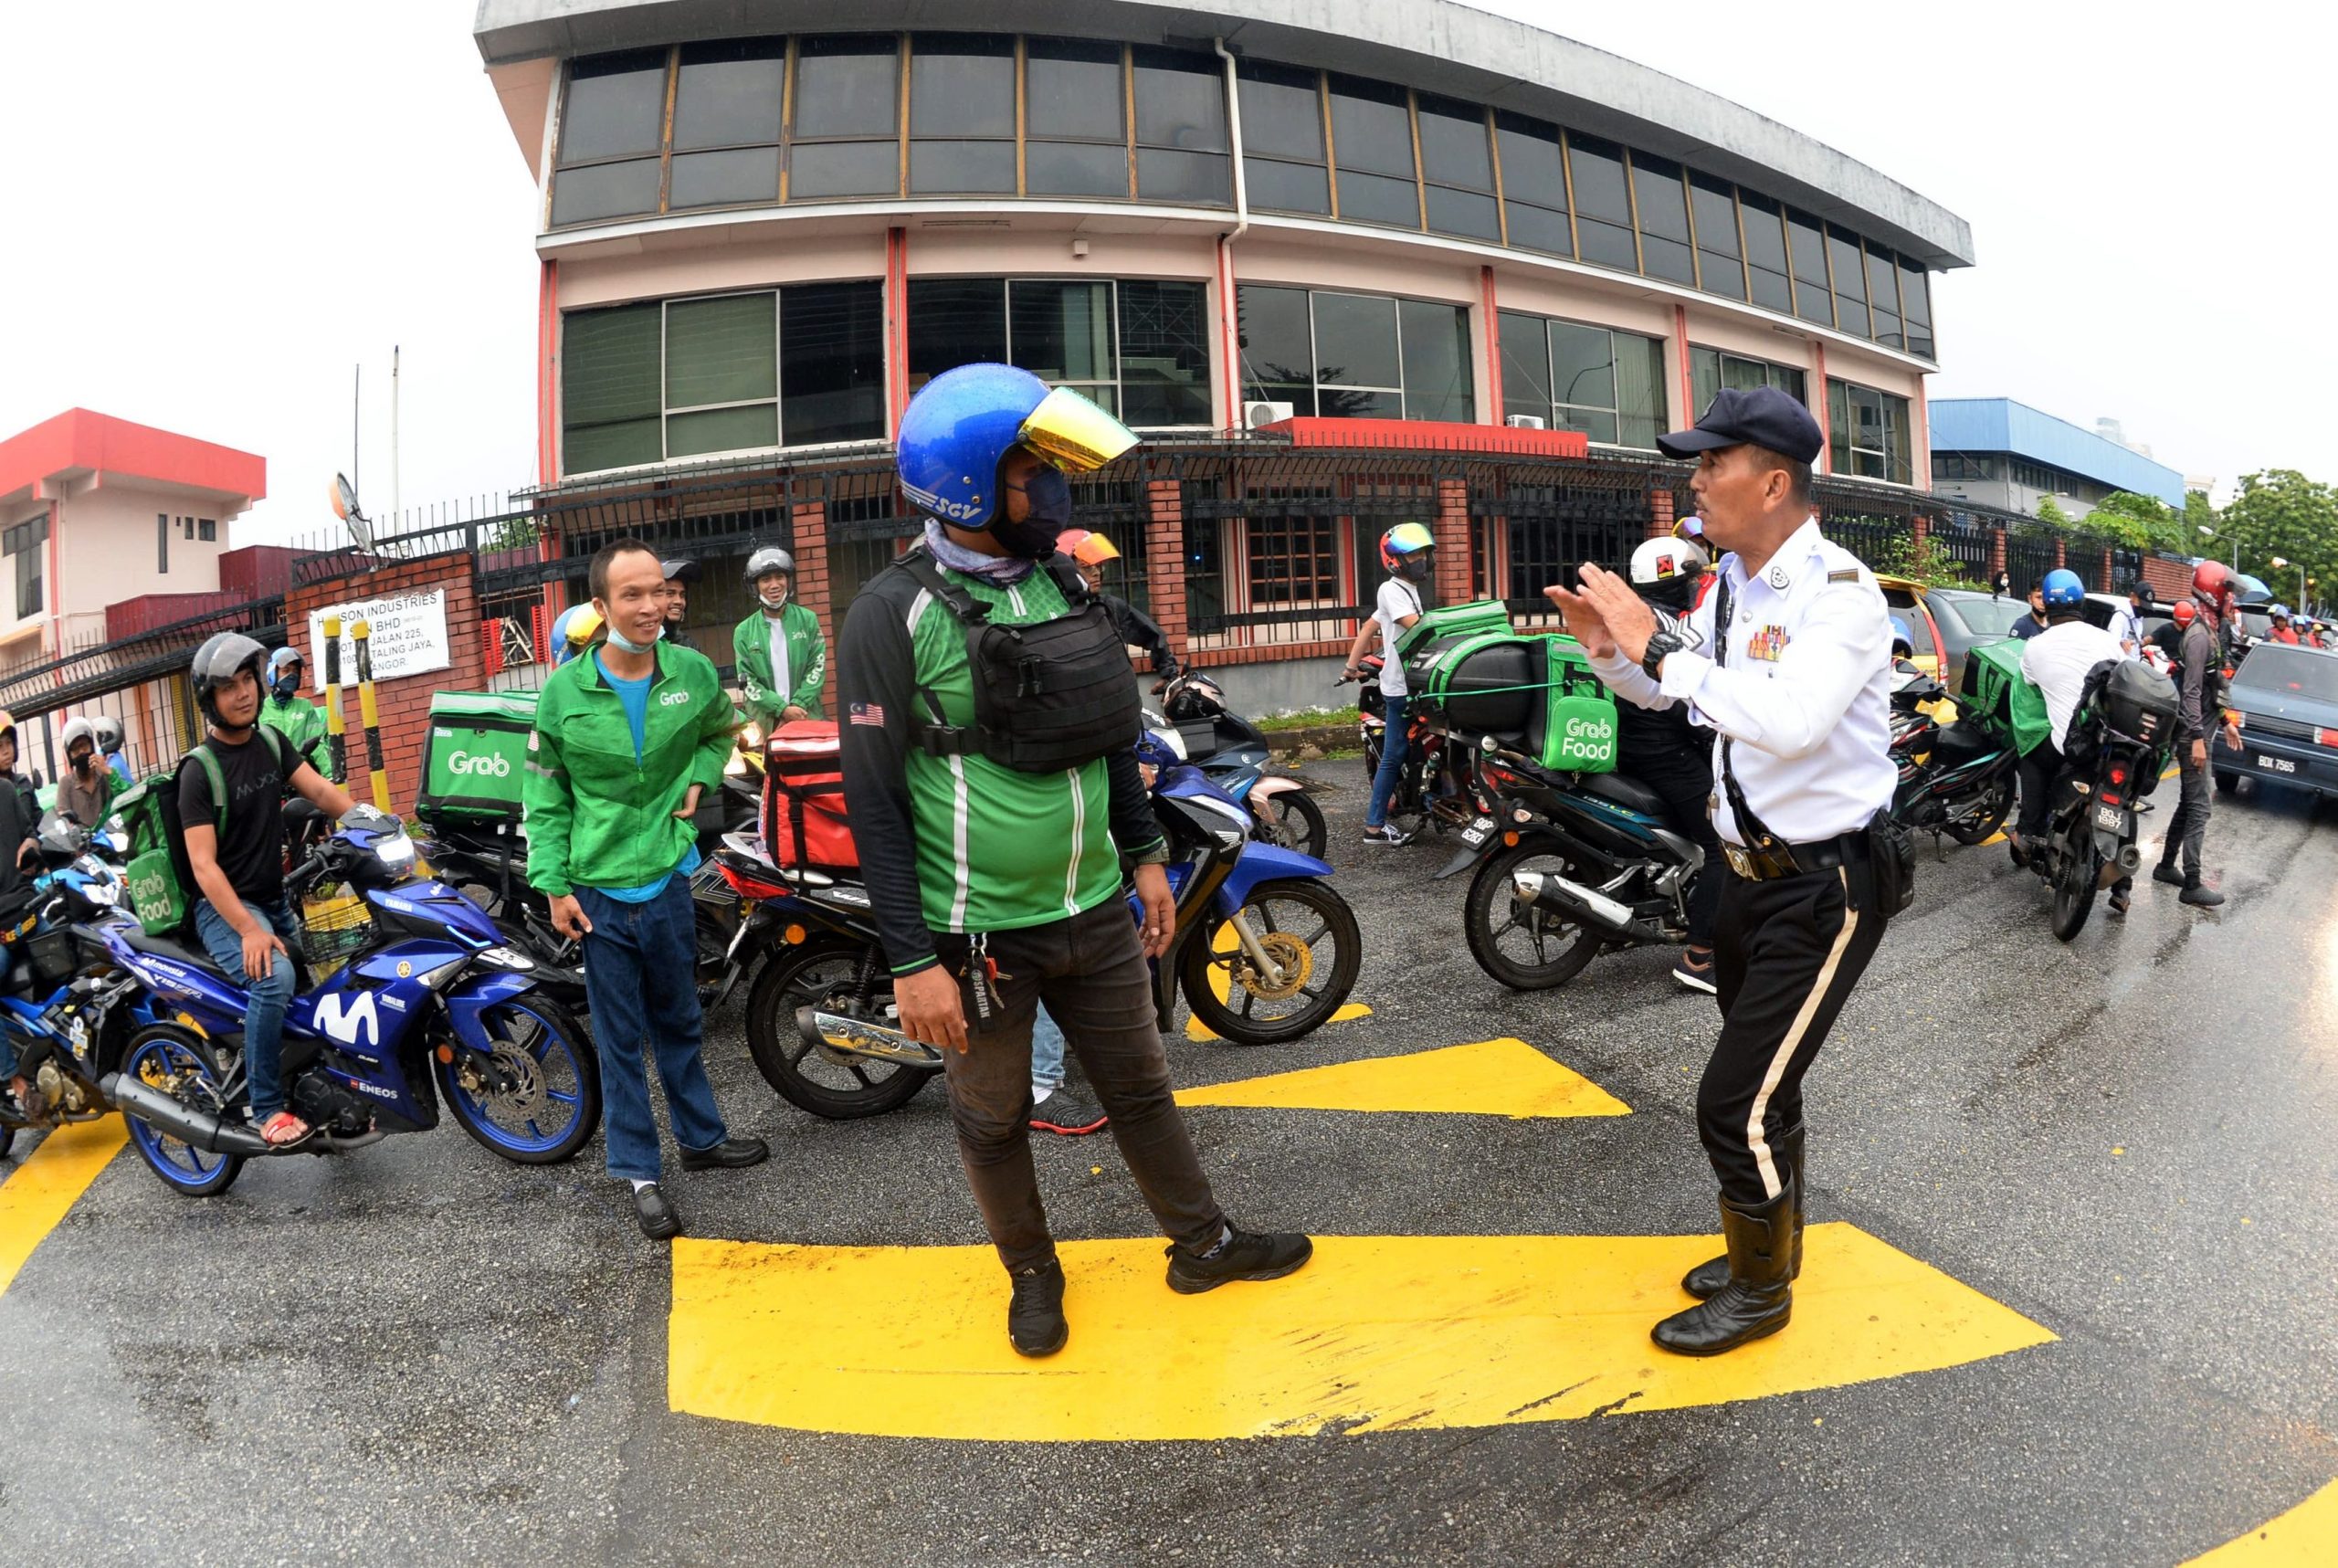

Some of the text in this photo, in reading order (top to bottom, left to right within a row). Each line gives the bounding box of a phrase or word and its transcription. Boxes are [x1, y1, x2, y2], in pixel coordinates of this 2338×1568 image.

[934, 497, 983, 520] SGV
[317, 594, 437, 627] HSON INDUSTRIES
[375, 617, 401, 633] BHD
[370, 632, 402, 647] JALAN
[405, 627, 424, 640] 225,
[370, 643, 405, 658] TALING
[806, 653, 826, 685] Grab
[659, 689, 690, 706] Grab
[1565, 717, 1612, 739] Grab
[1562, 737, 1612, 761] Food
[448, 750, 511, 778] Grab
[132, 869, 165, 900] Grab
[138, 893, 172, 923] Food
[973, 981, 991, 1018] SPARTAN
[359, 1081, 398, 1100] ENEOS
